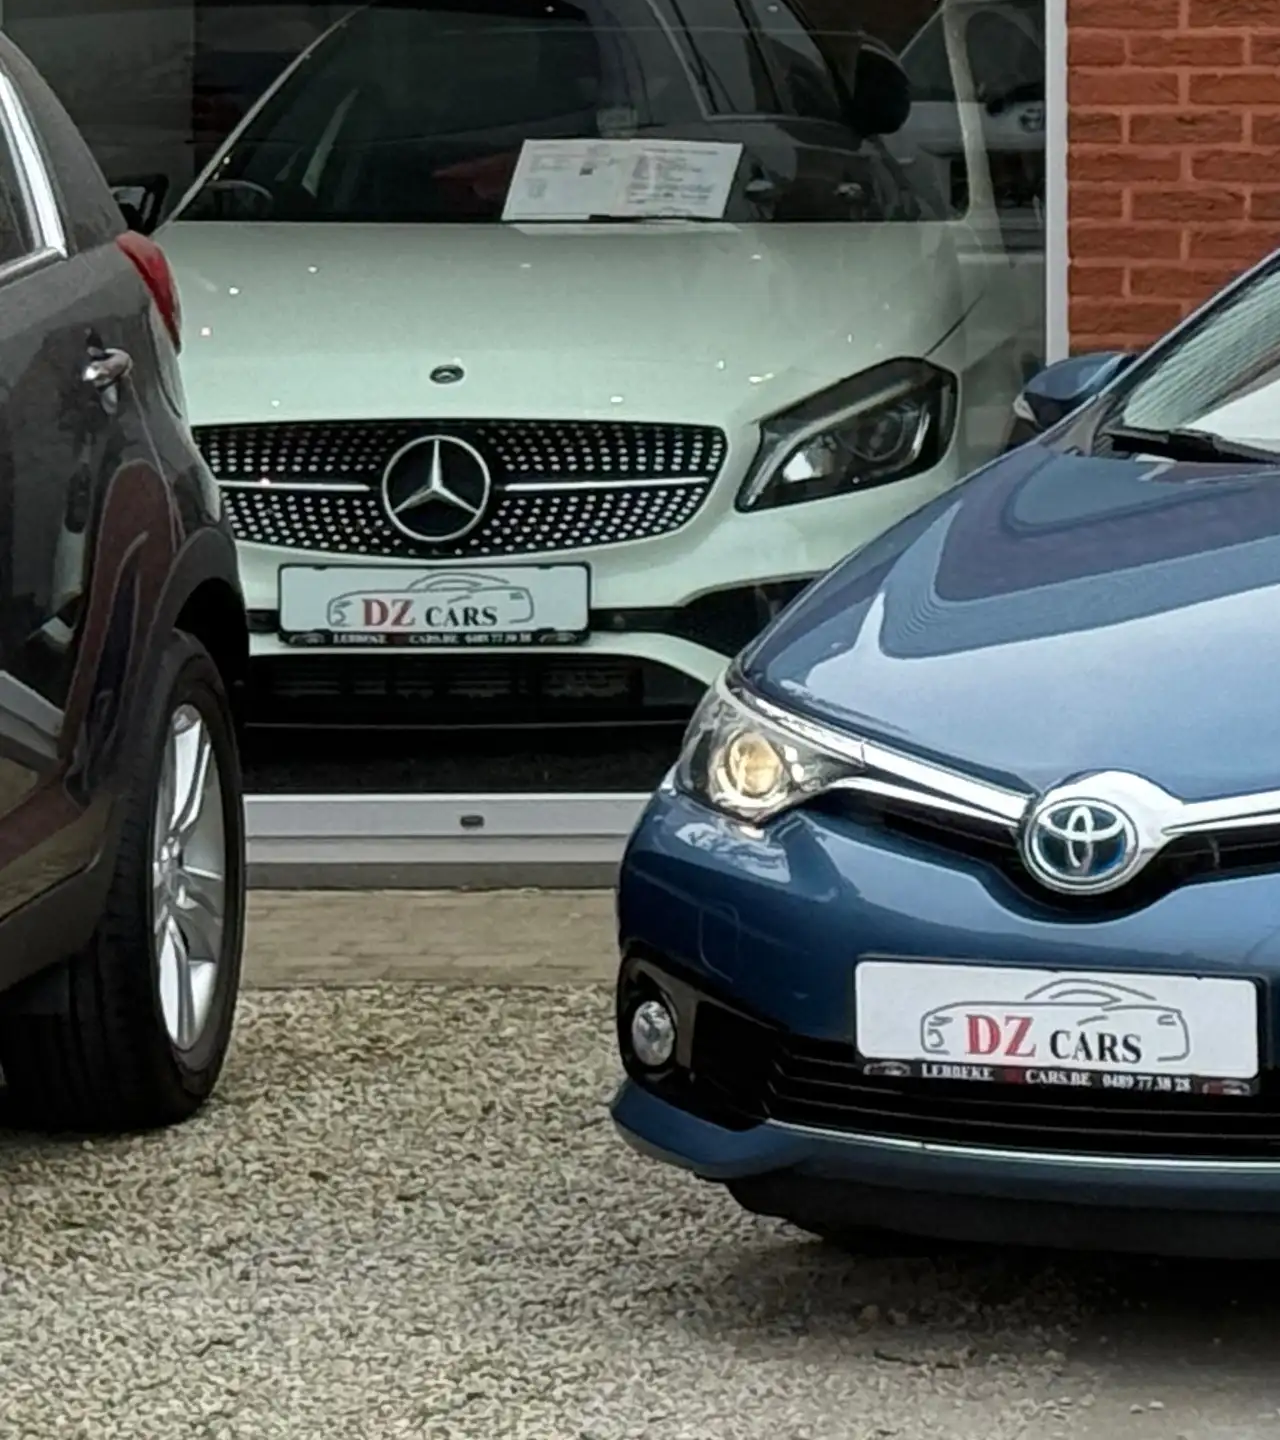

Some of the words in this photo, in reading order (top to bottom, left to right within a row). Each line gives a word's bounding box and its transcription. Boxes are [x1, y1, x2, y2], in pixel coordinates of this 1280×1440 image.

[361, 597, 417, 628] DZ
[425, 605, 499, 628] CARS
[964, 1014, 1038, 1058] DZ
[1048, 1029, 1143, 1064] CARS
